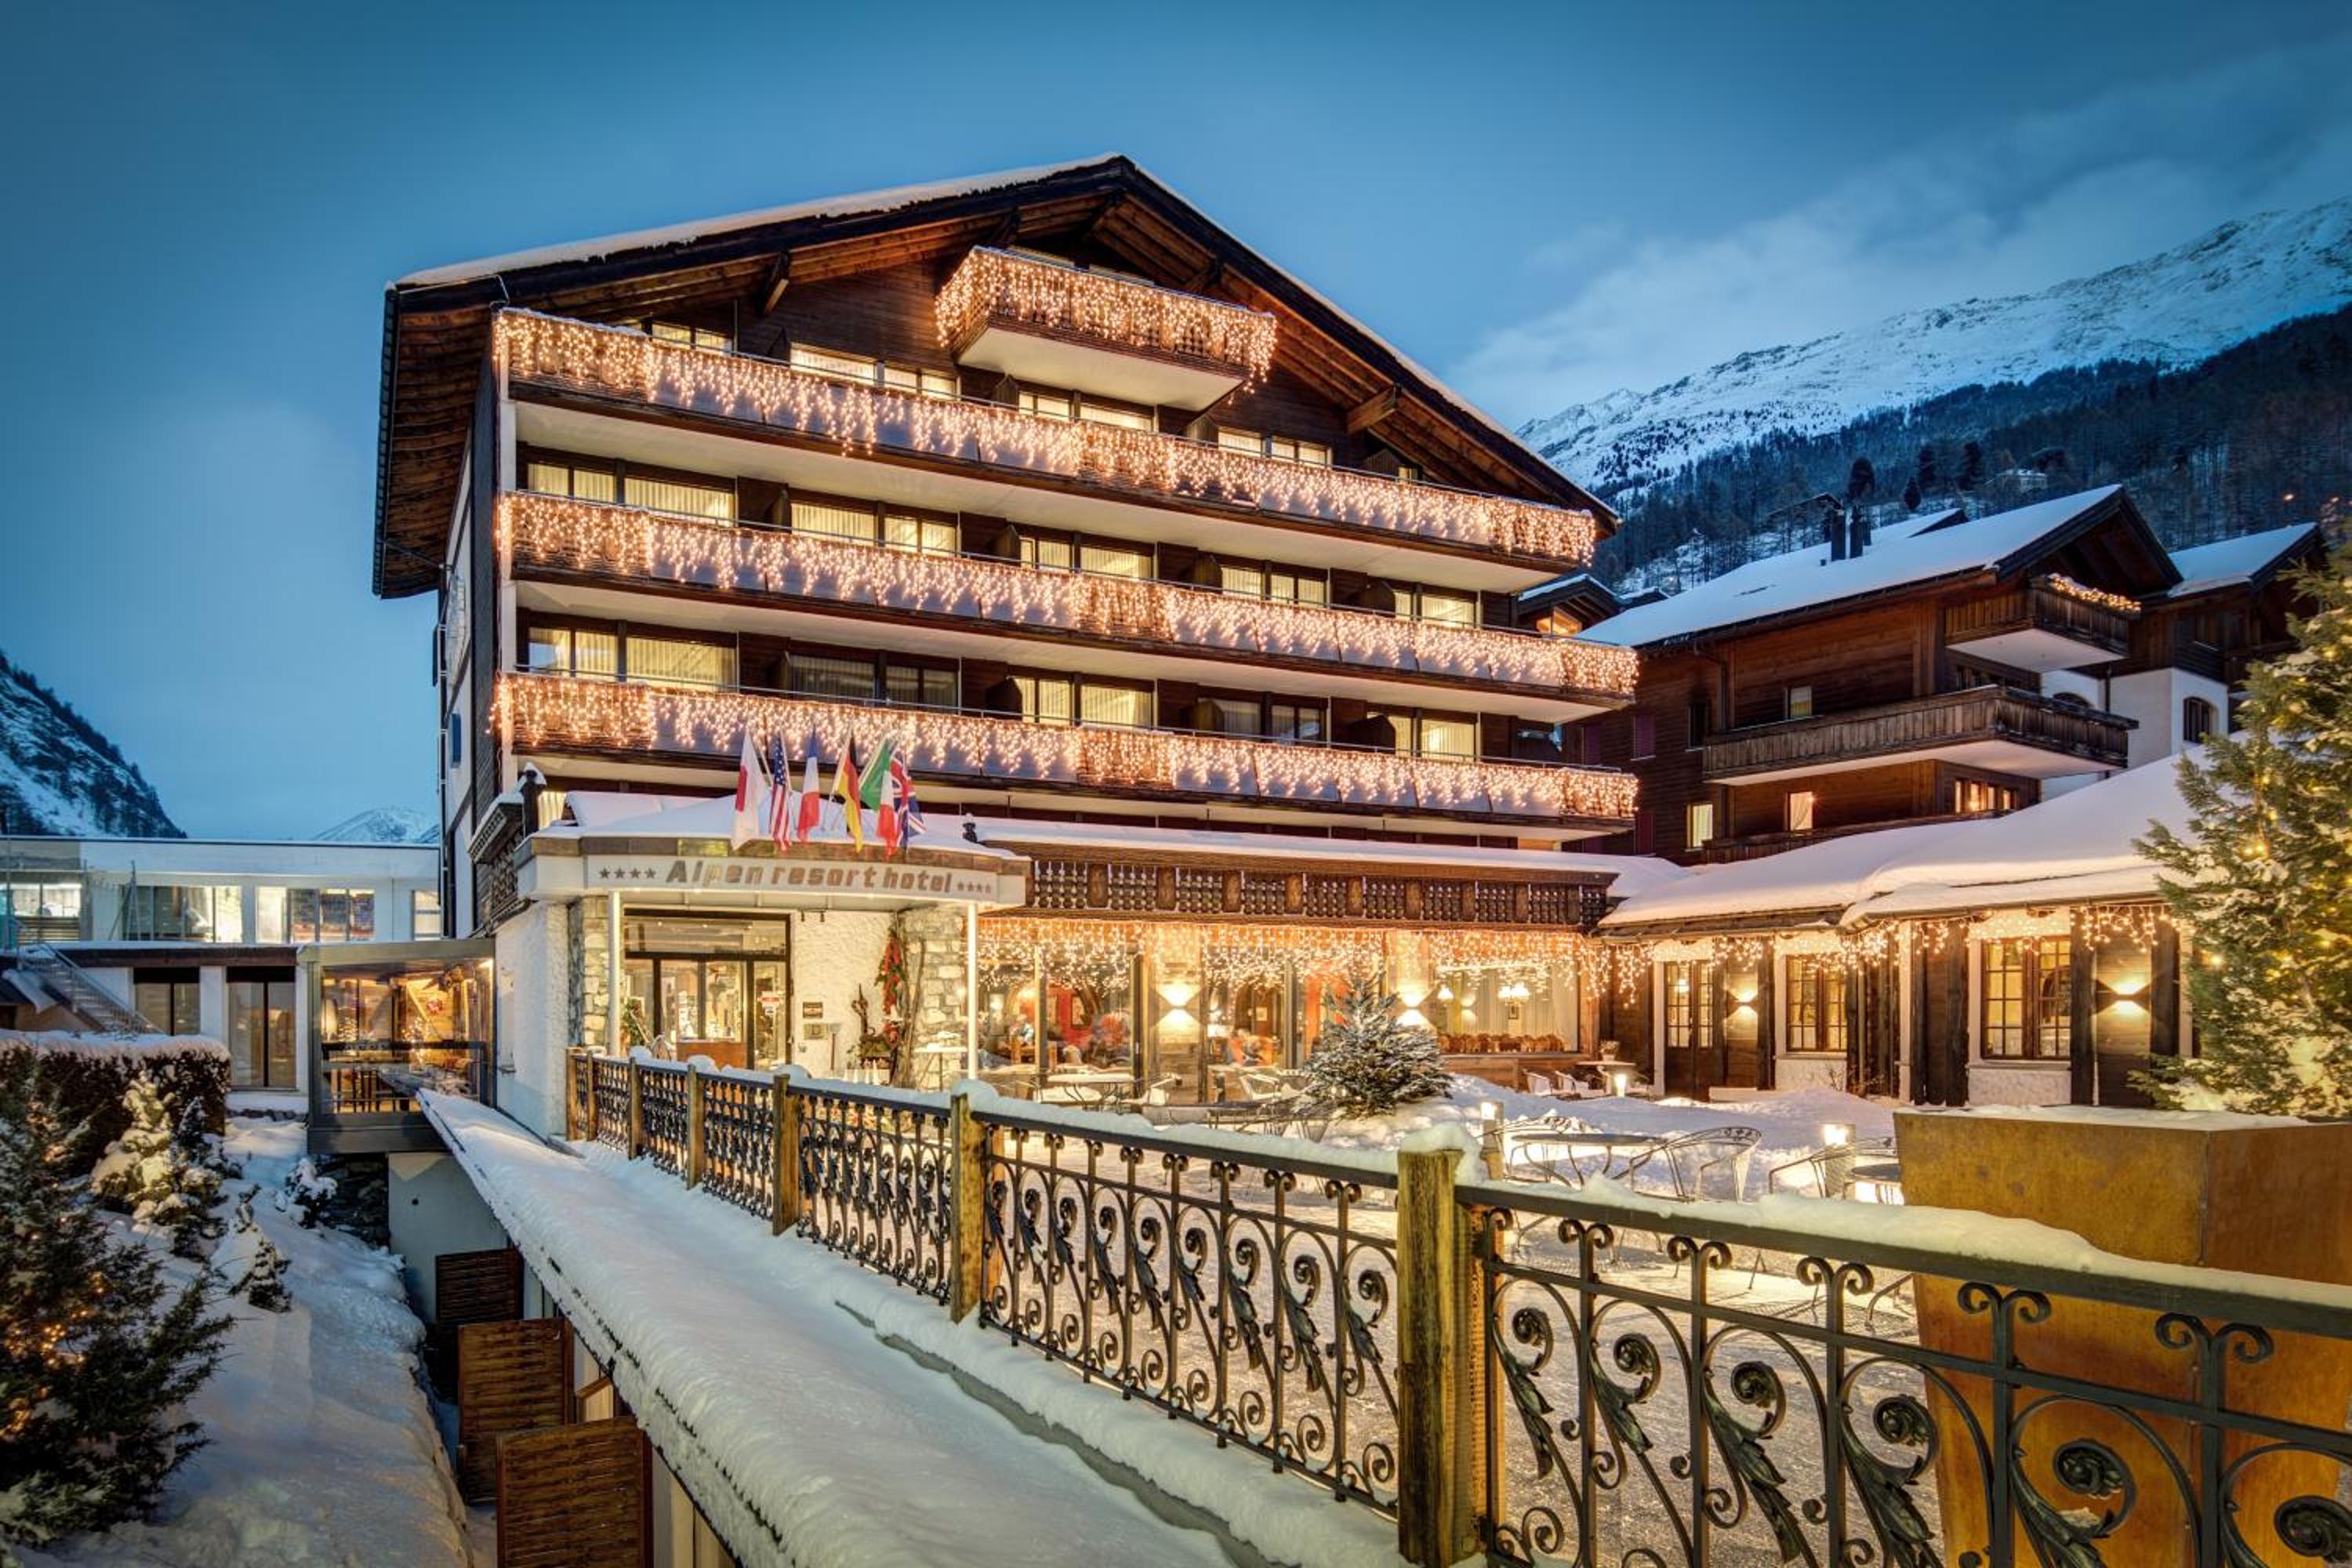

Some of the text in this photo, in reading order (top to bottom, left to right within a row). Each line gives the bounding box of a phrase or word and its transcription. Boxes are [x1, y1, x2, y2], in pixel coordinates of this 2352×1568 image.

[666, 860, 953, 893] Alpen resort hotel
